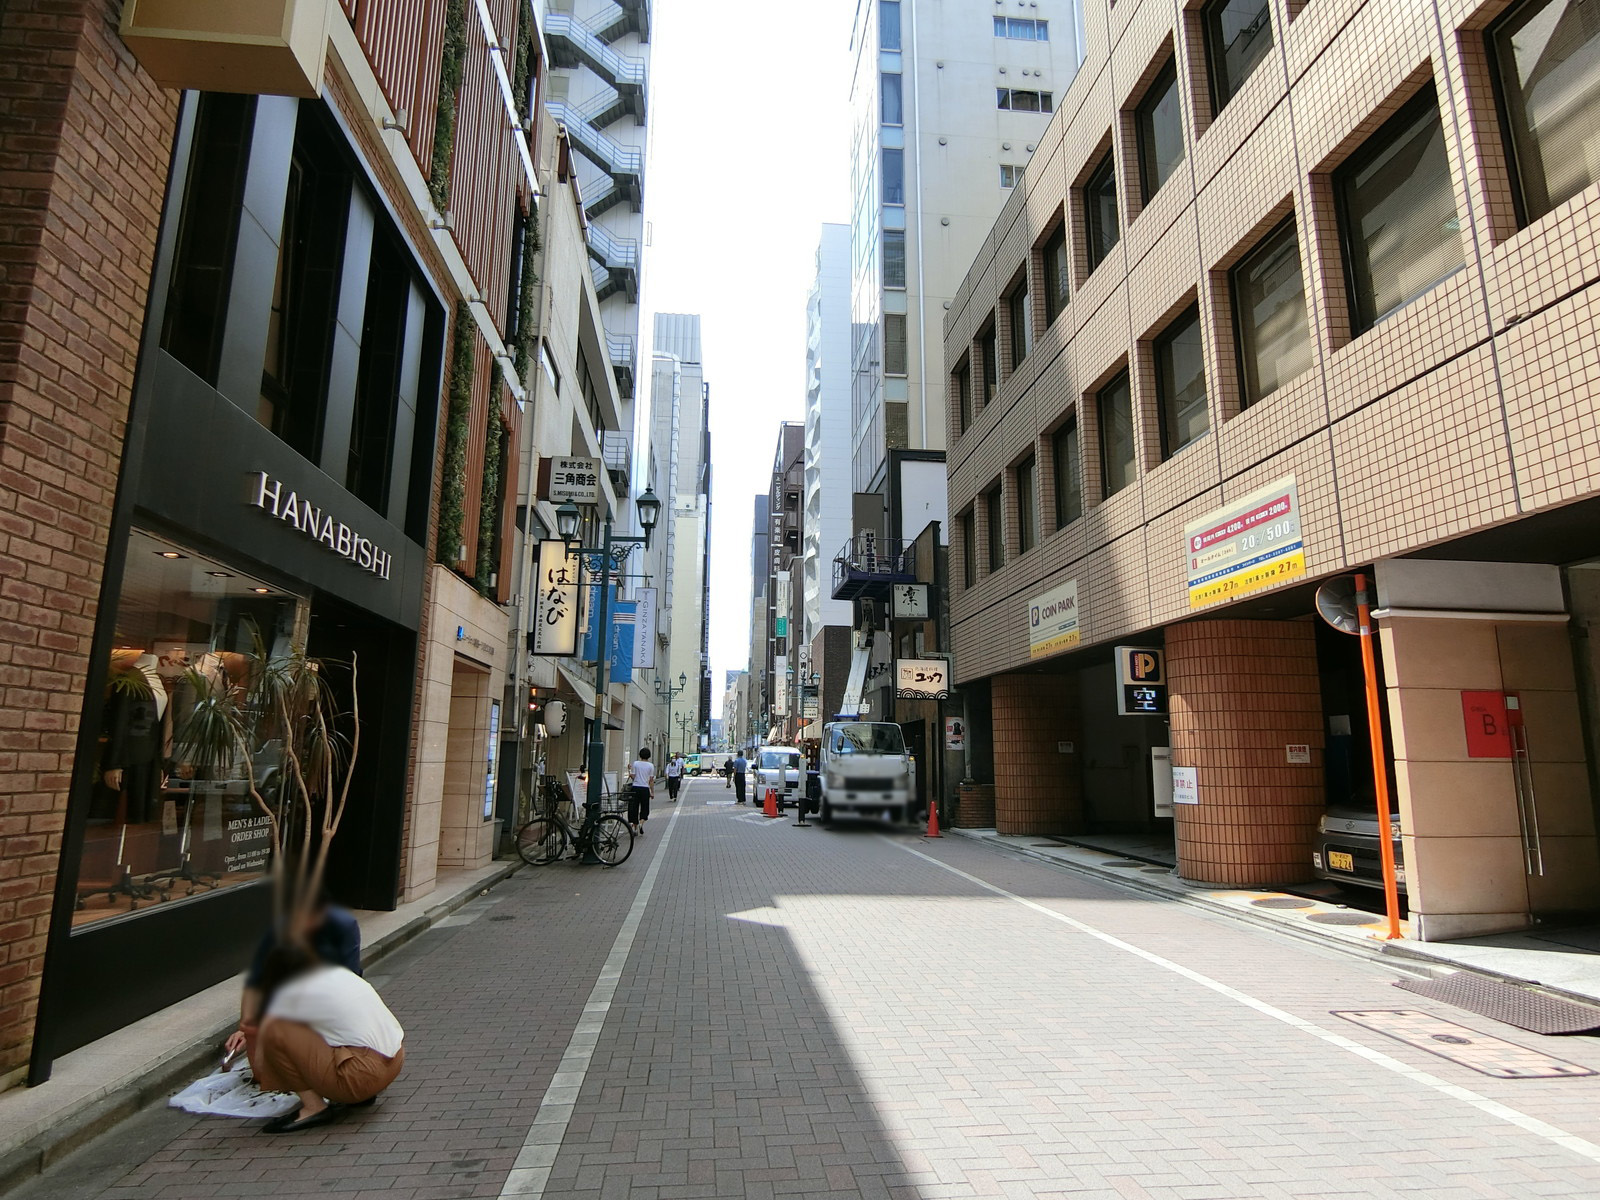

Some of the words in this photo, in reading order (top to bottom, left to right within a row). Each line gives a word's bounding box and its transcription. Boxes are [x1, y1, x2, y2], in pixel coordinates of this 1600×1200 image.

[560, 461, 593, 470] 株式会社
[553, 472, 597, 487] 三角商会
[257, 470, 392, 581] HANABISHI
[546, 566, 571, 626] はなび
[1041, 602, 1057, 620] COIN
[1058, 595, 1075, 614] PARK
[586, 625, 593, 640] on
[914, 672, 943, 684] ユック
[1133, 687, 1157, 711] 空
[1483, 713, 1497, 735] B
[228, 818, 247, 830] MEN'S
[248, 818, 254, 828] &
[231, 830, 253, 843] ORDER
[253, 827, 270, 839] SHOP
